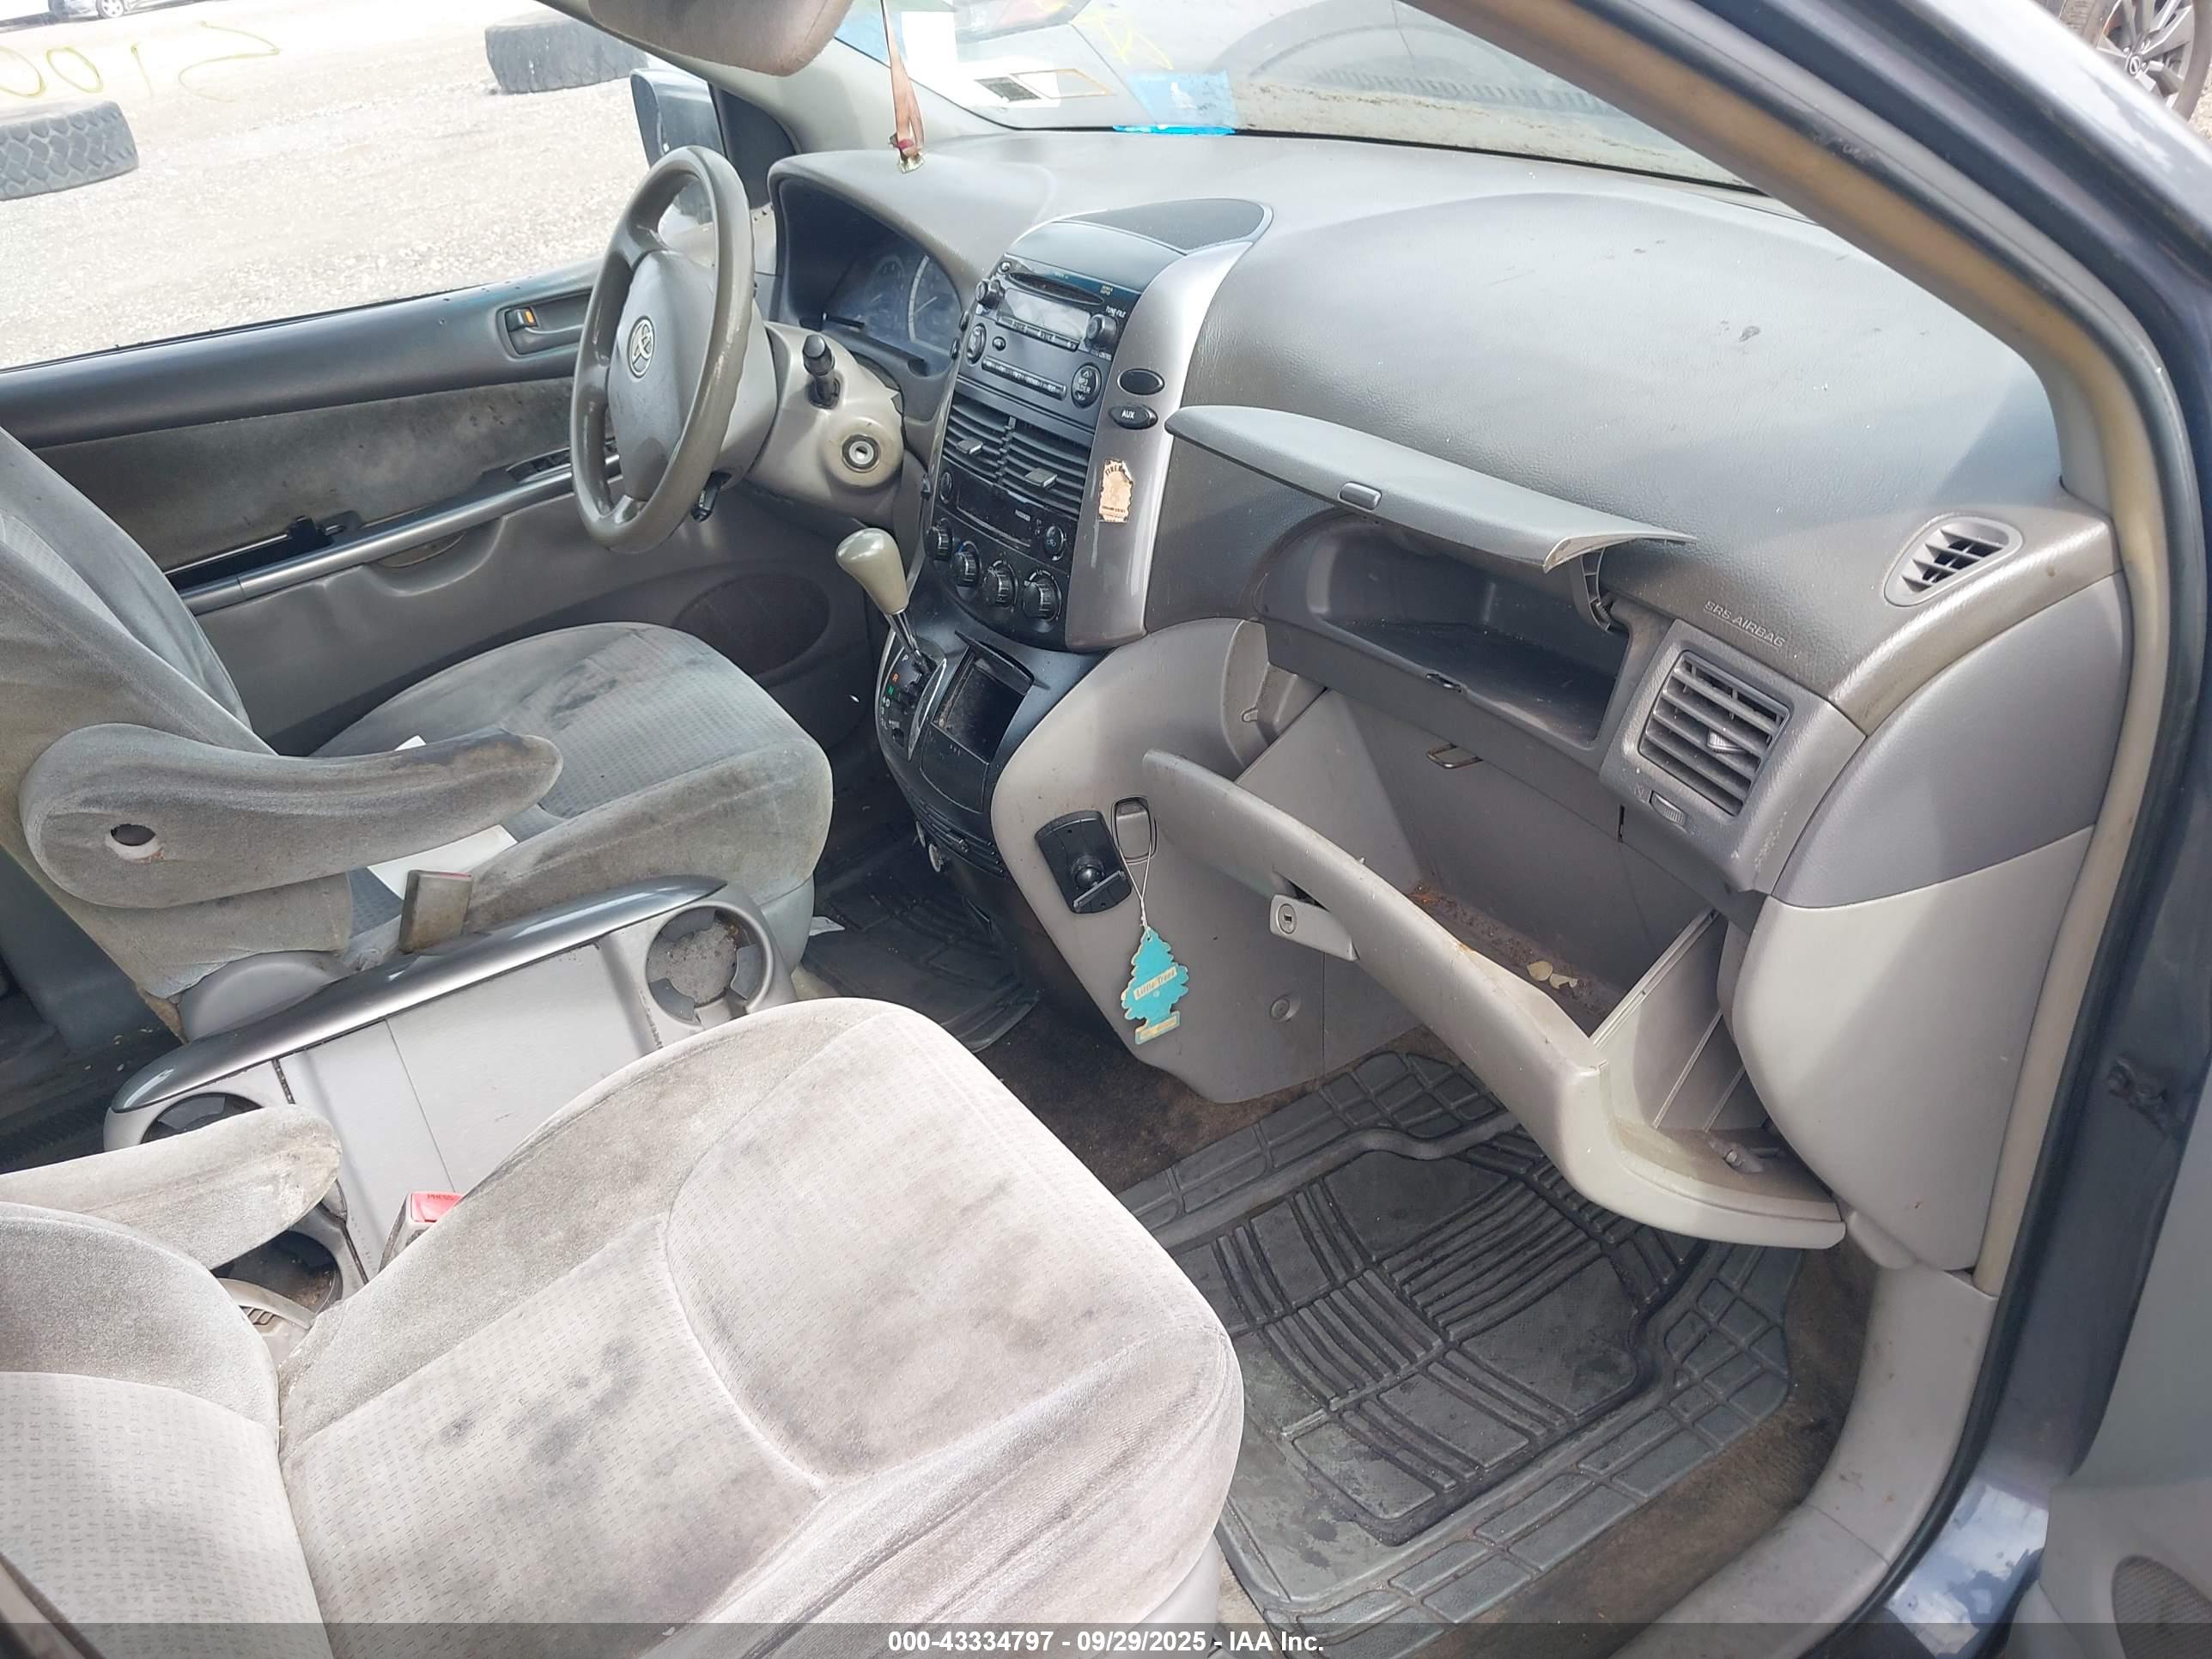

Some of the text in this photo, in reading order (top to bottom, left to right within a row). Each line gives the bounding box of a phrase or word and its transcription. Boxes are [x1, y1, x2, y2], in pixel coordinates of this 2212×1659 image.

[1121, 409, 1135, 420] AUX
[1704, 600, 1786, 647] SRS AIRBAG
[892, 673, 899, 683] R
